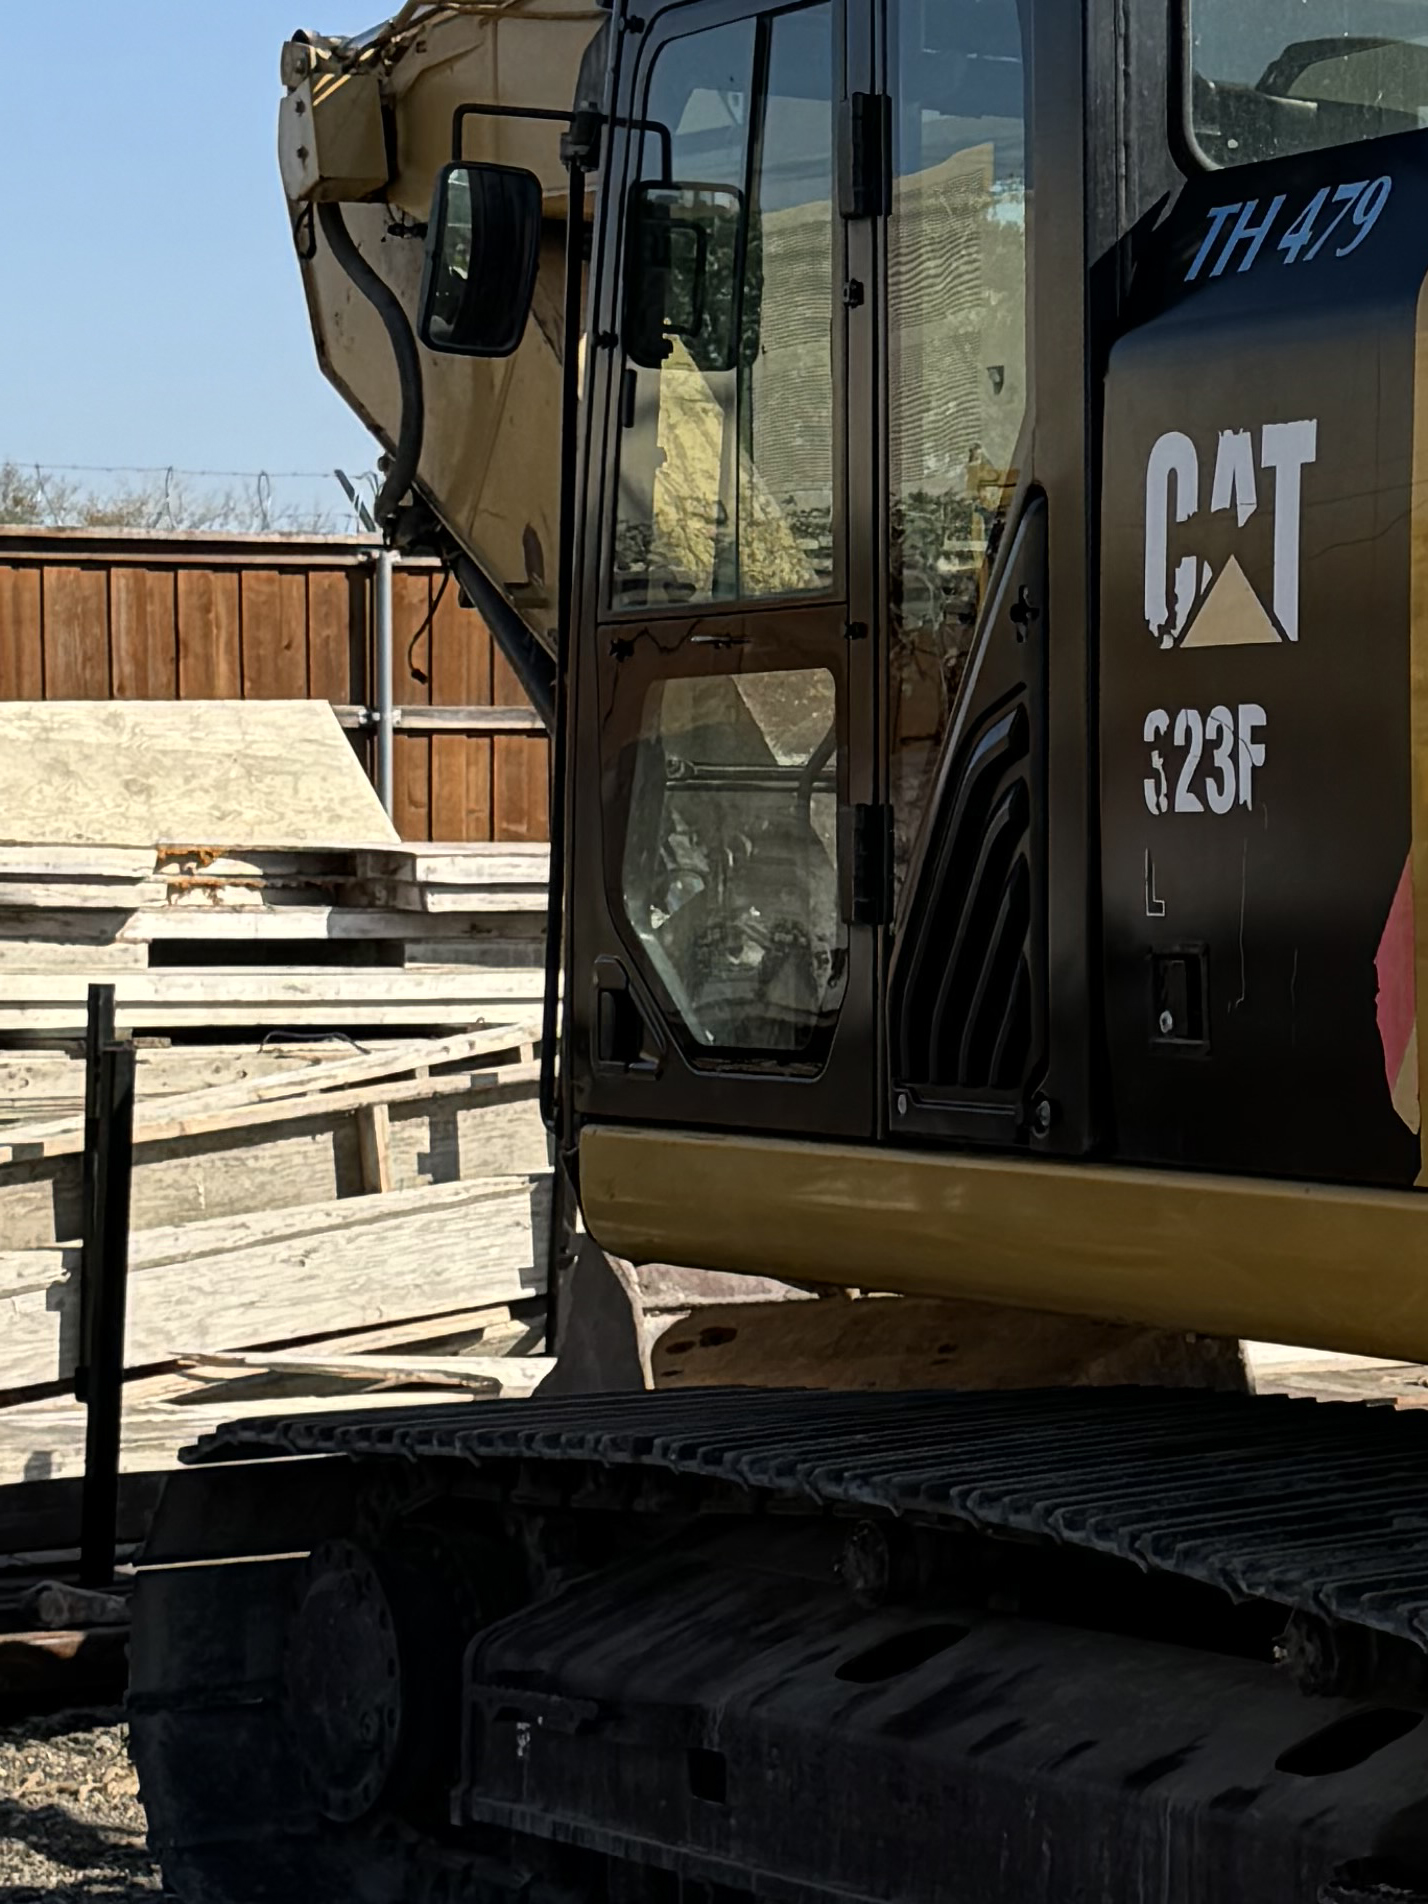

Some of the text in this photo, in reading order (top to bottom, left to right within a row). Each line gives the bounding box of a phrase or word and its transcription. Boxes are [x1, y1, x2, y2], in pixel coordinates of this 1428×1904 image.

[1184, 175, 1392, 283] TH 479
[1144, 418, 1318, 650] CAT
[1143, 703, 1267, 816] 323F
